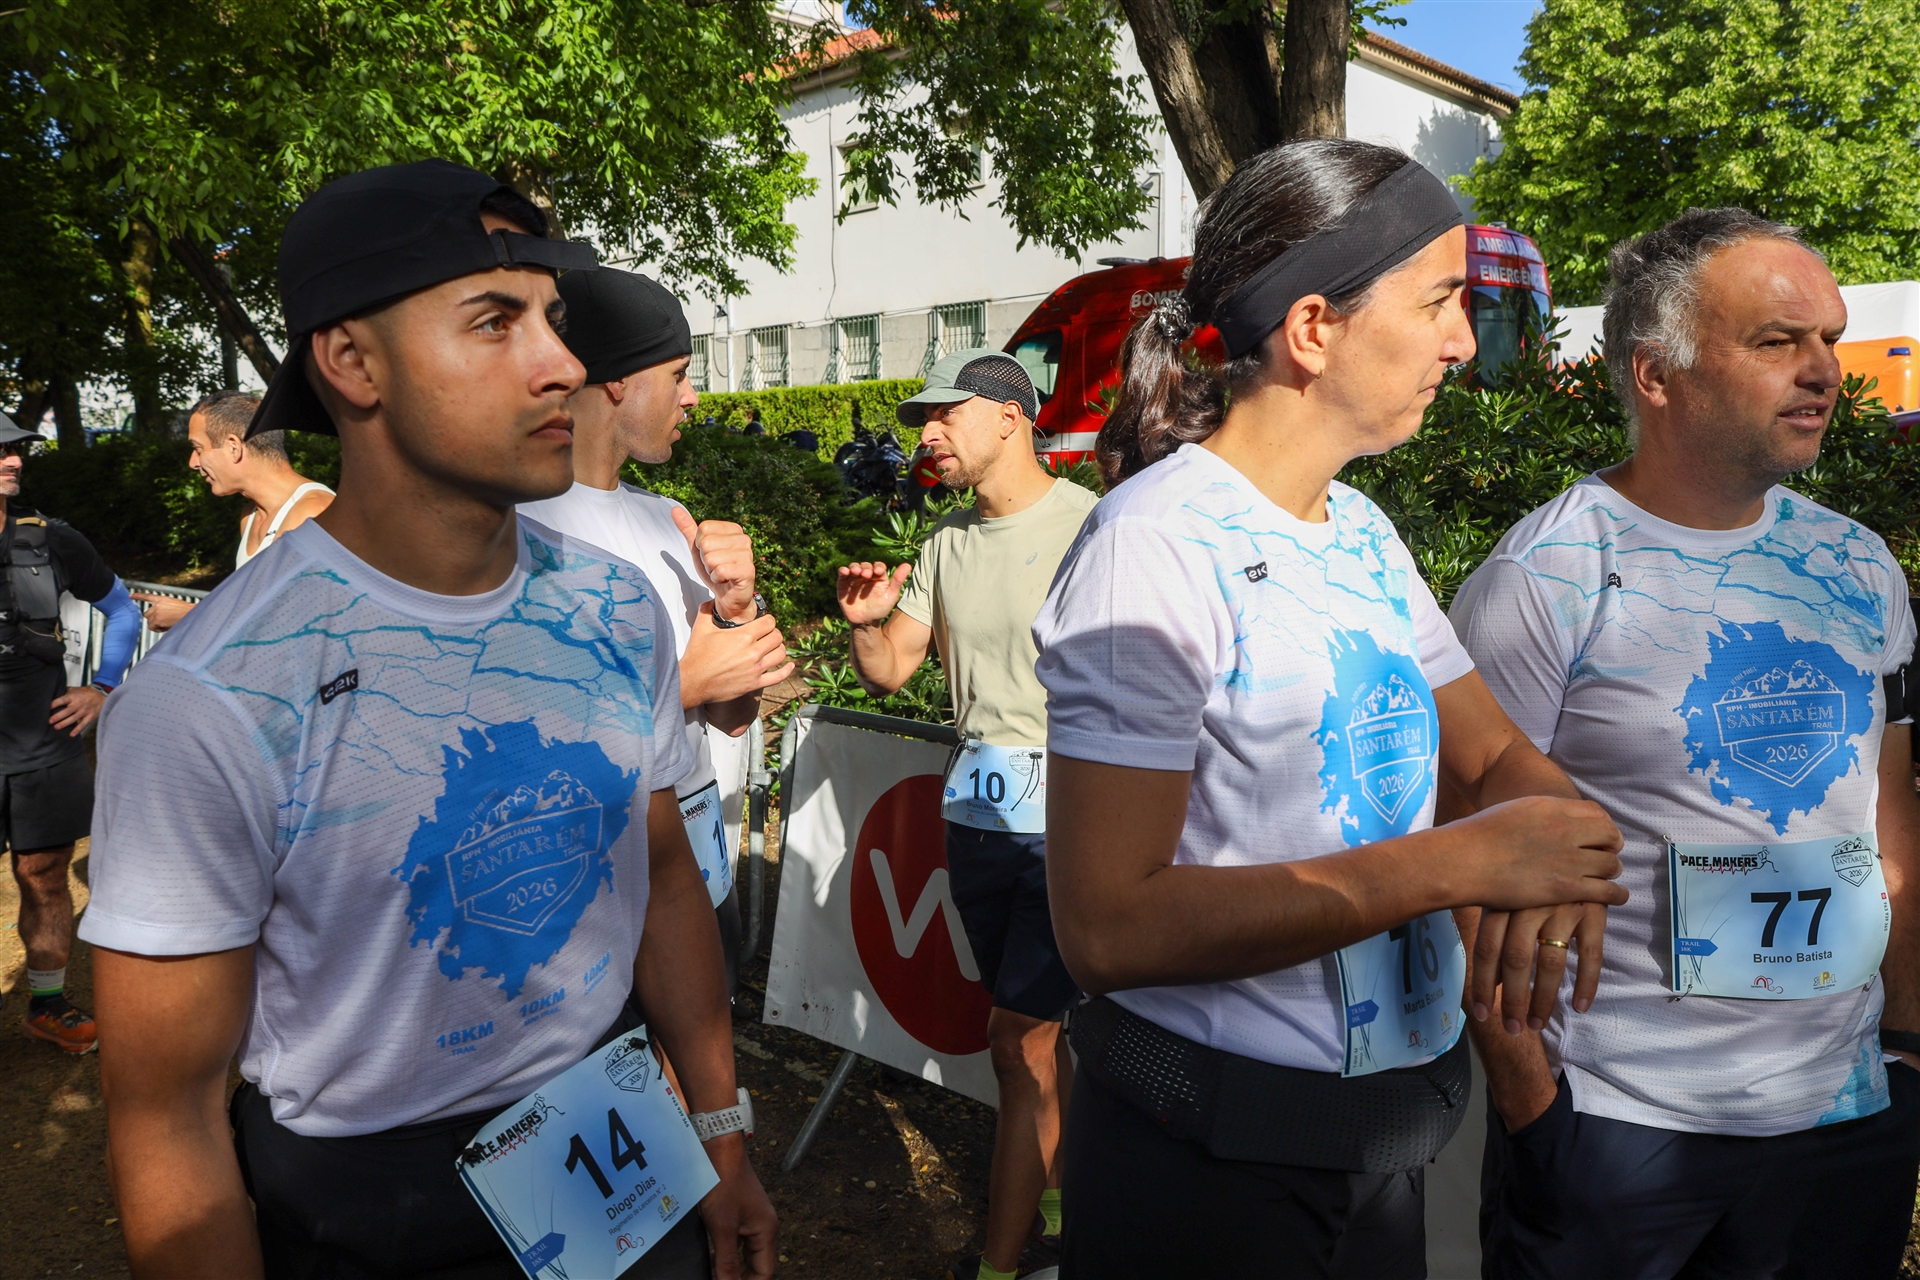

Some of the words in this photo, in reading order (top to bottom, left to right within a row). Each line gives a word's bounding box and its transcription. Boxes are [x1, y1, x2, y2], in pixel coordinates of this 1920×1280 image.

[1726, 704, 1742, 712] RPH
[1727, 703, 1834, 729] SANTARÉM
[1355, 725, 1421, 757] SANTARÉM
[1407, 745, 1422, 755] TRAIL
[1765, 743, 1808, 764] 2026
[969, 768, 1006, 804] 10
[1378, 772, 1405, 798] 2026
[966, 800, 982, 809] Bruno
[461, 823, 586, 883] SANTARÉM
[462, 846, 481, 861] RPH
[563, 843, 585, 857] TRAIL
[507, 878, 557, 914] 2026
[1751, 887, 1832, 948] 77
[583, 951, 611, 985] 10KM
[1388, 915, 1439, 995] 76
[1753, 953, 1793, 963] Bruno
[1796, 950, 1833, 963] Batista
[519, 987, 566, 1018] 10KM
[1351, 1005, 1366, 1015] TRAIL
[1403, 999, 1426, 1015] Marta
[436, 1019, 494, 1049] 18KM
[450, 1045, 477, 1056] TRAIL
[564, 1107, 648, 1200] 14
[605, 1193, 637, 1220] Diogo
[634, 1176, 657, 1197] Dias
[608, 1213, 634, 1235] Regimento
[632, 1208, 640, 1216] de
[637, 1192, 658, 1211] Lanceiros
[526, 1243, 548, 1260] TRAIL
[531, 1256, 545, 1268] 18K
